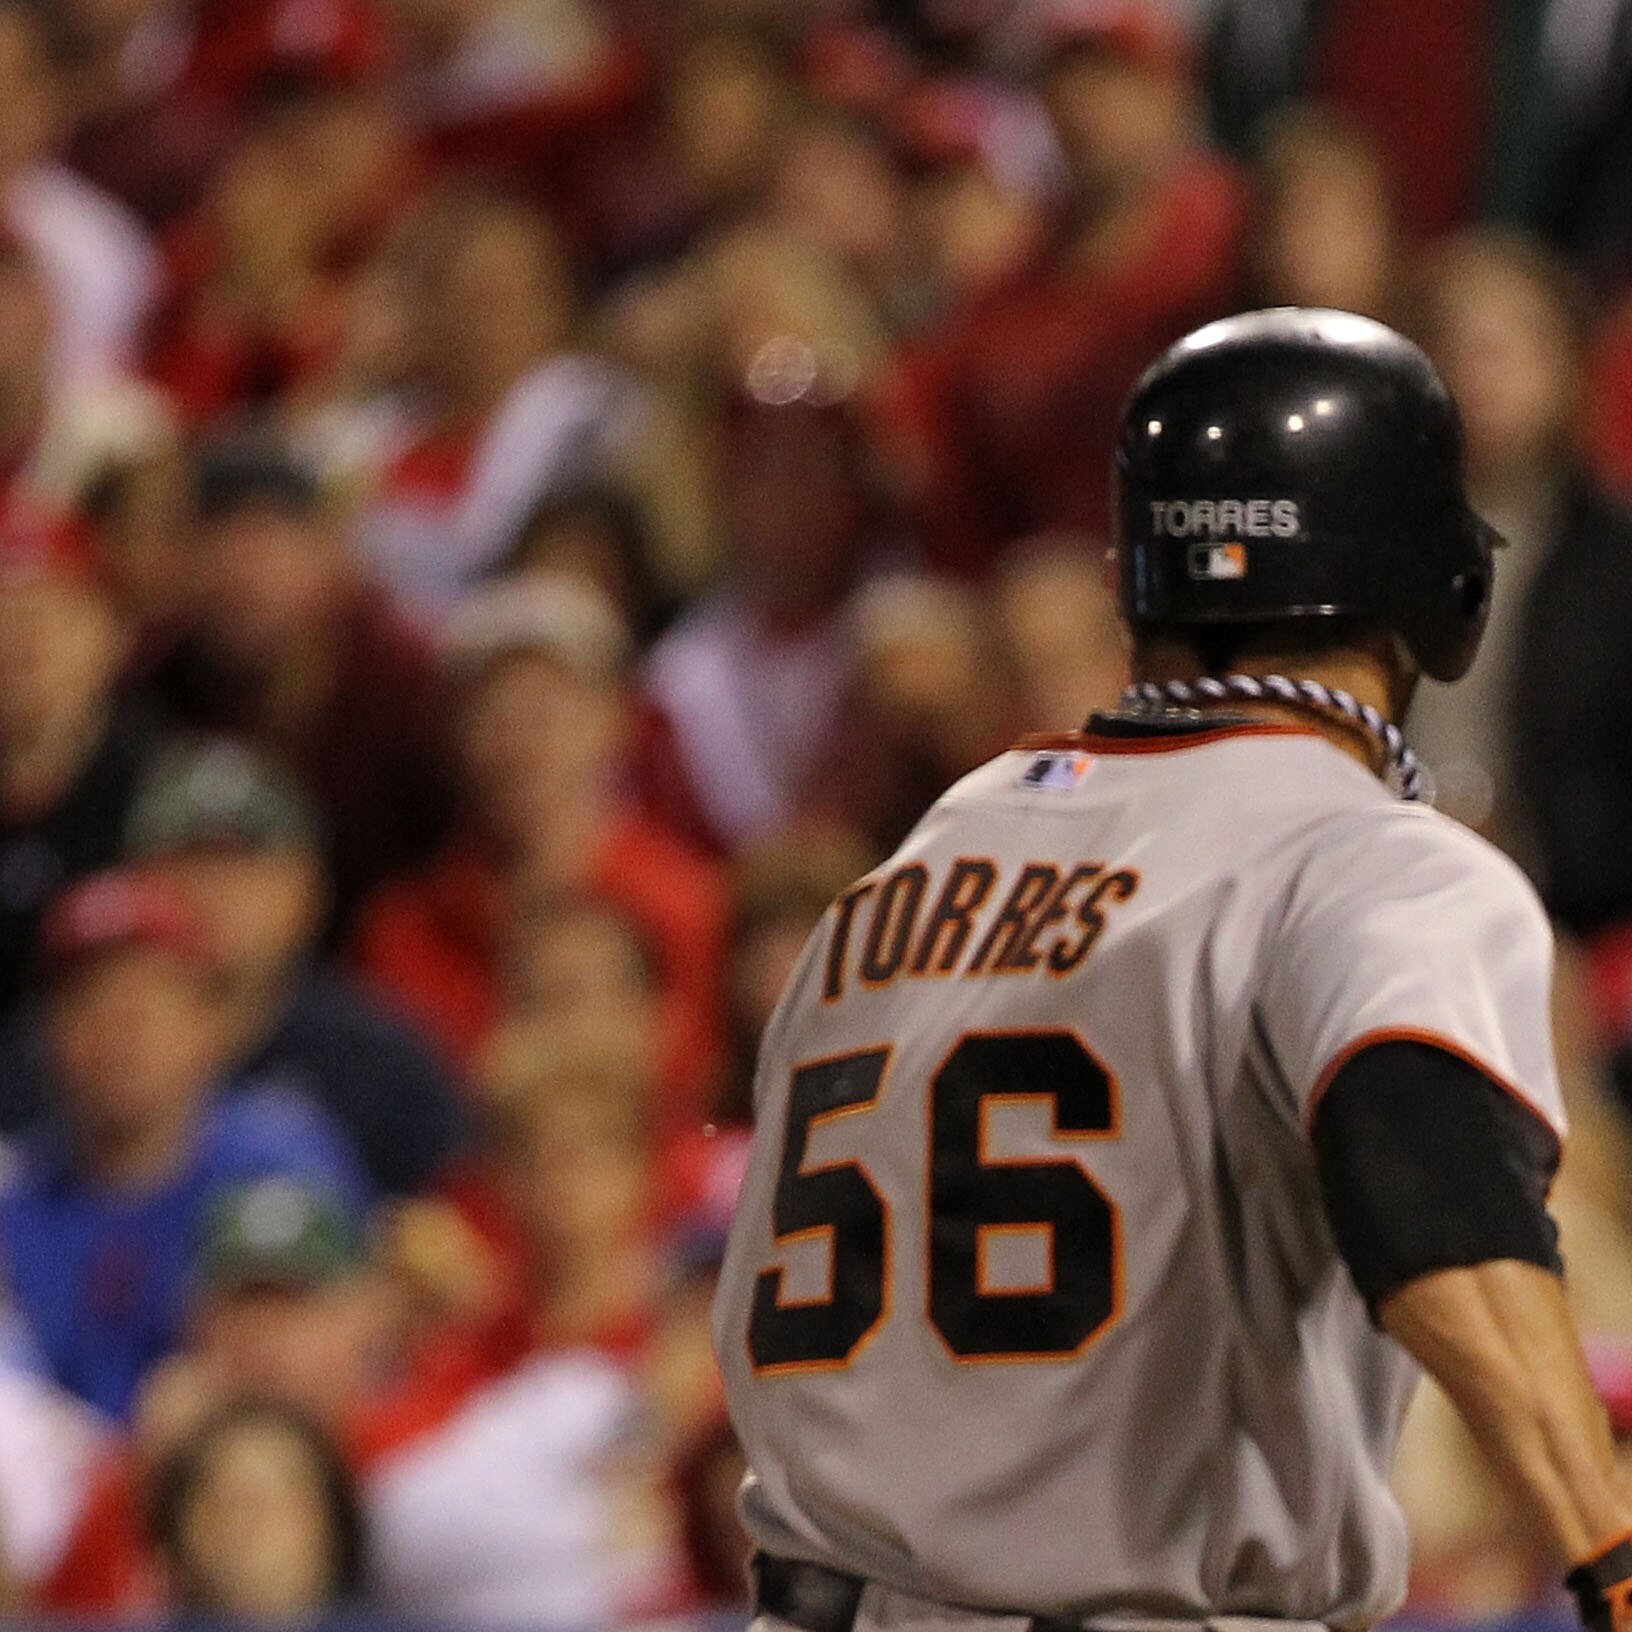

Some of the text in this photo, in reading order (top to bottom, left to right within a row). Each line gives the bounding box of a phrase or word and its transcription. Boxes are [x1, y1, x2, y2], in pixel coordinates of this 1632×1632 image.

[1150, 498, 1301, 538] TORRES
[821, 855, 1141, 1006] TORRES
[746, 1024, 1126, 1379] 56
